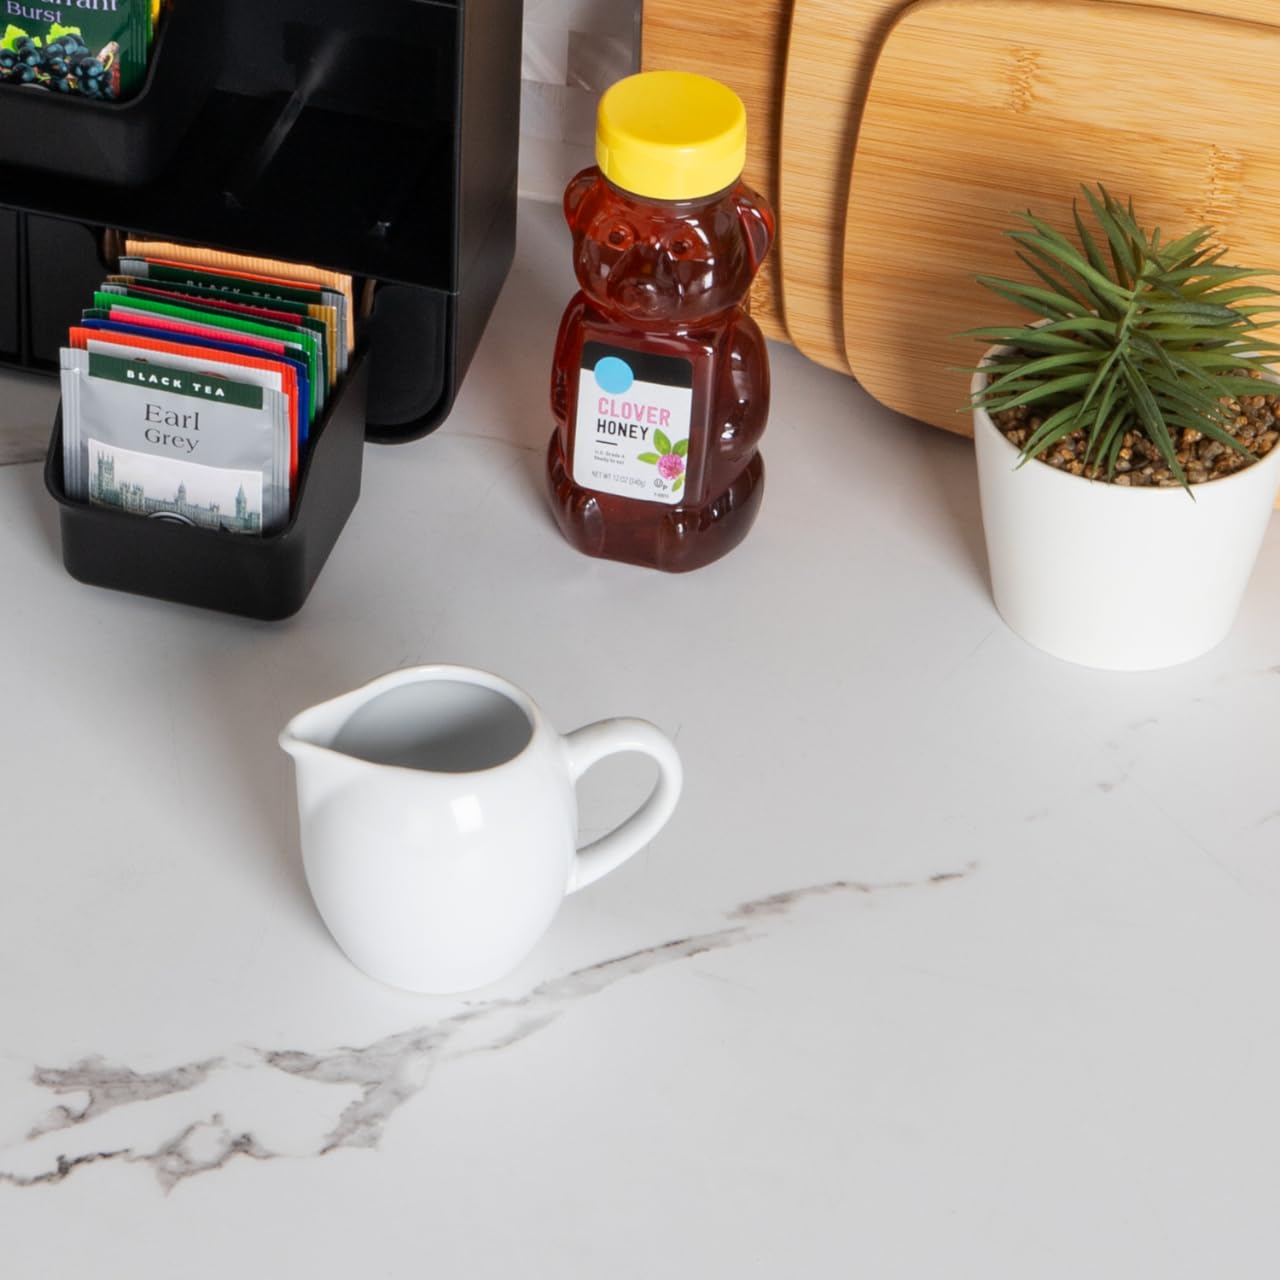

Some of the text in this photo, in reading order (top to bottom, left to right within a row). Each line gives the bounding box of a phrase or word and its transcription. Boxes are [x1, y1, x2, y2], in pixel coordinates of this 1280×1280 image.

[7, 0, 62, 23] Burst
[126, 370, 225, 397] BLACK TEA
[144, 403, 200, 431] Earl
[598, 397, 670, 426] CLOVER
[144, 428, 200, 453] Grey
[597, 418, 649, 440] HONEY
